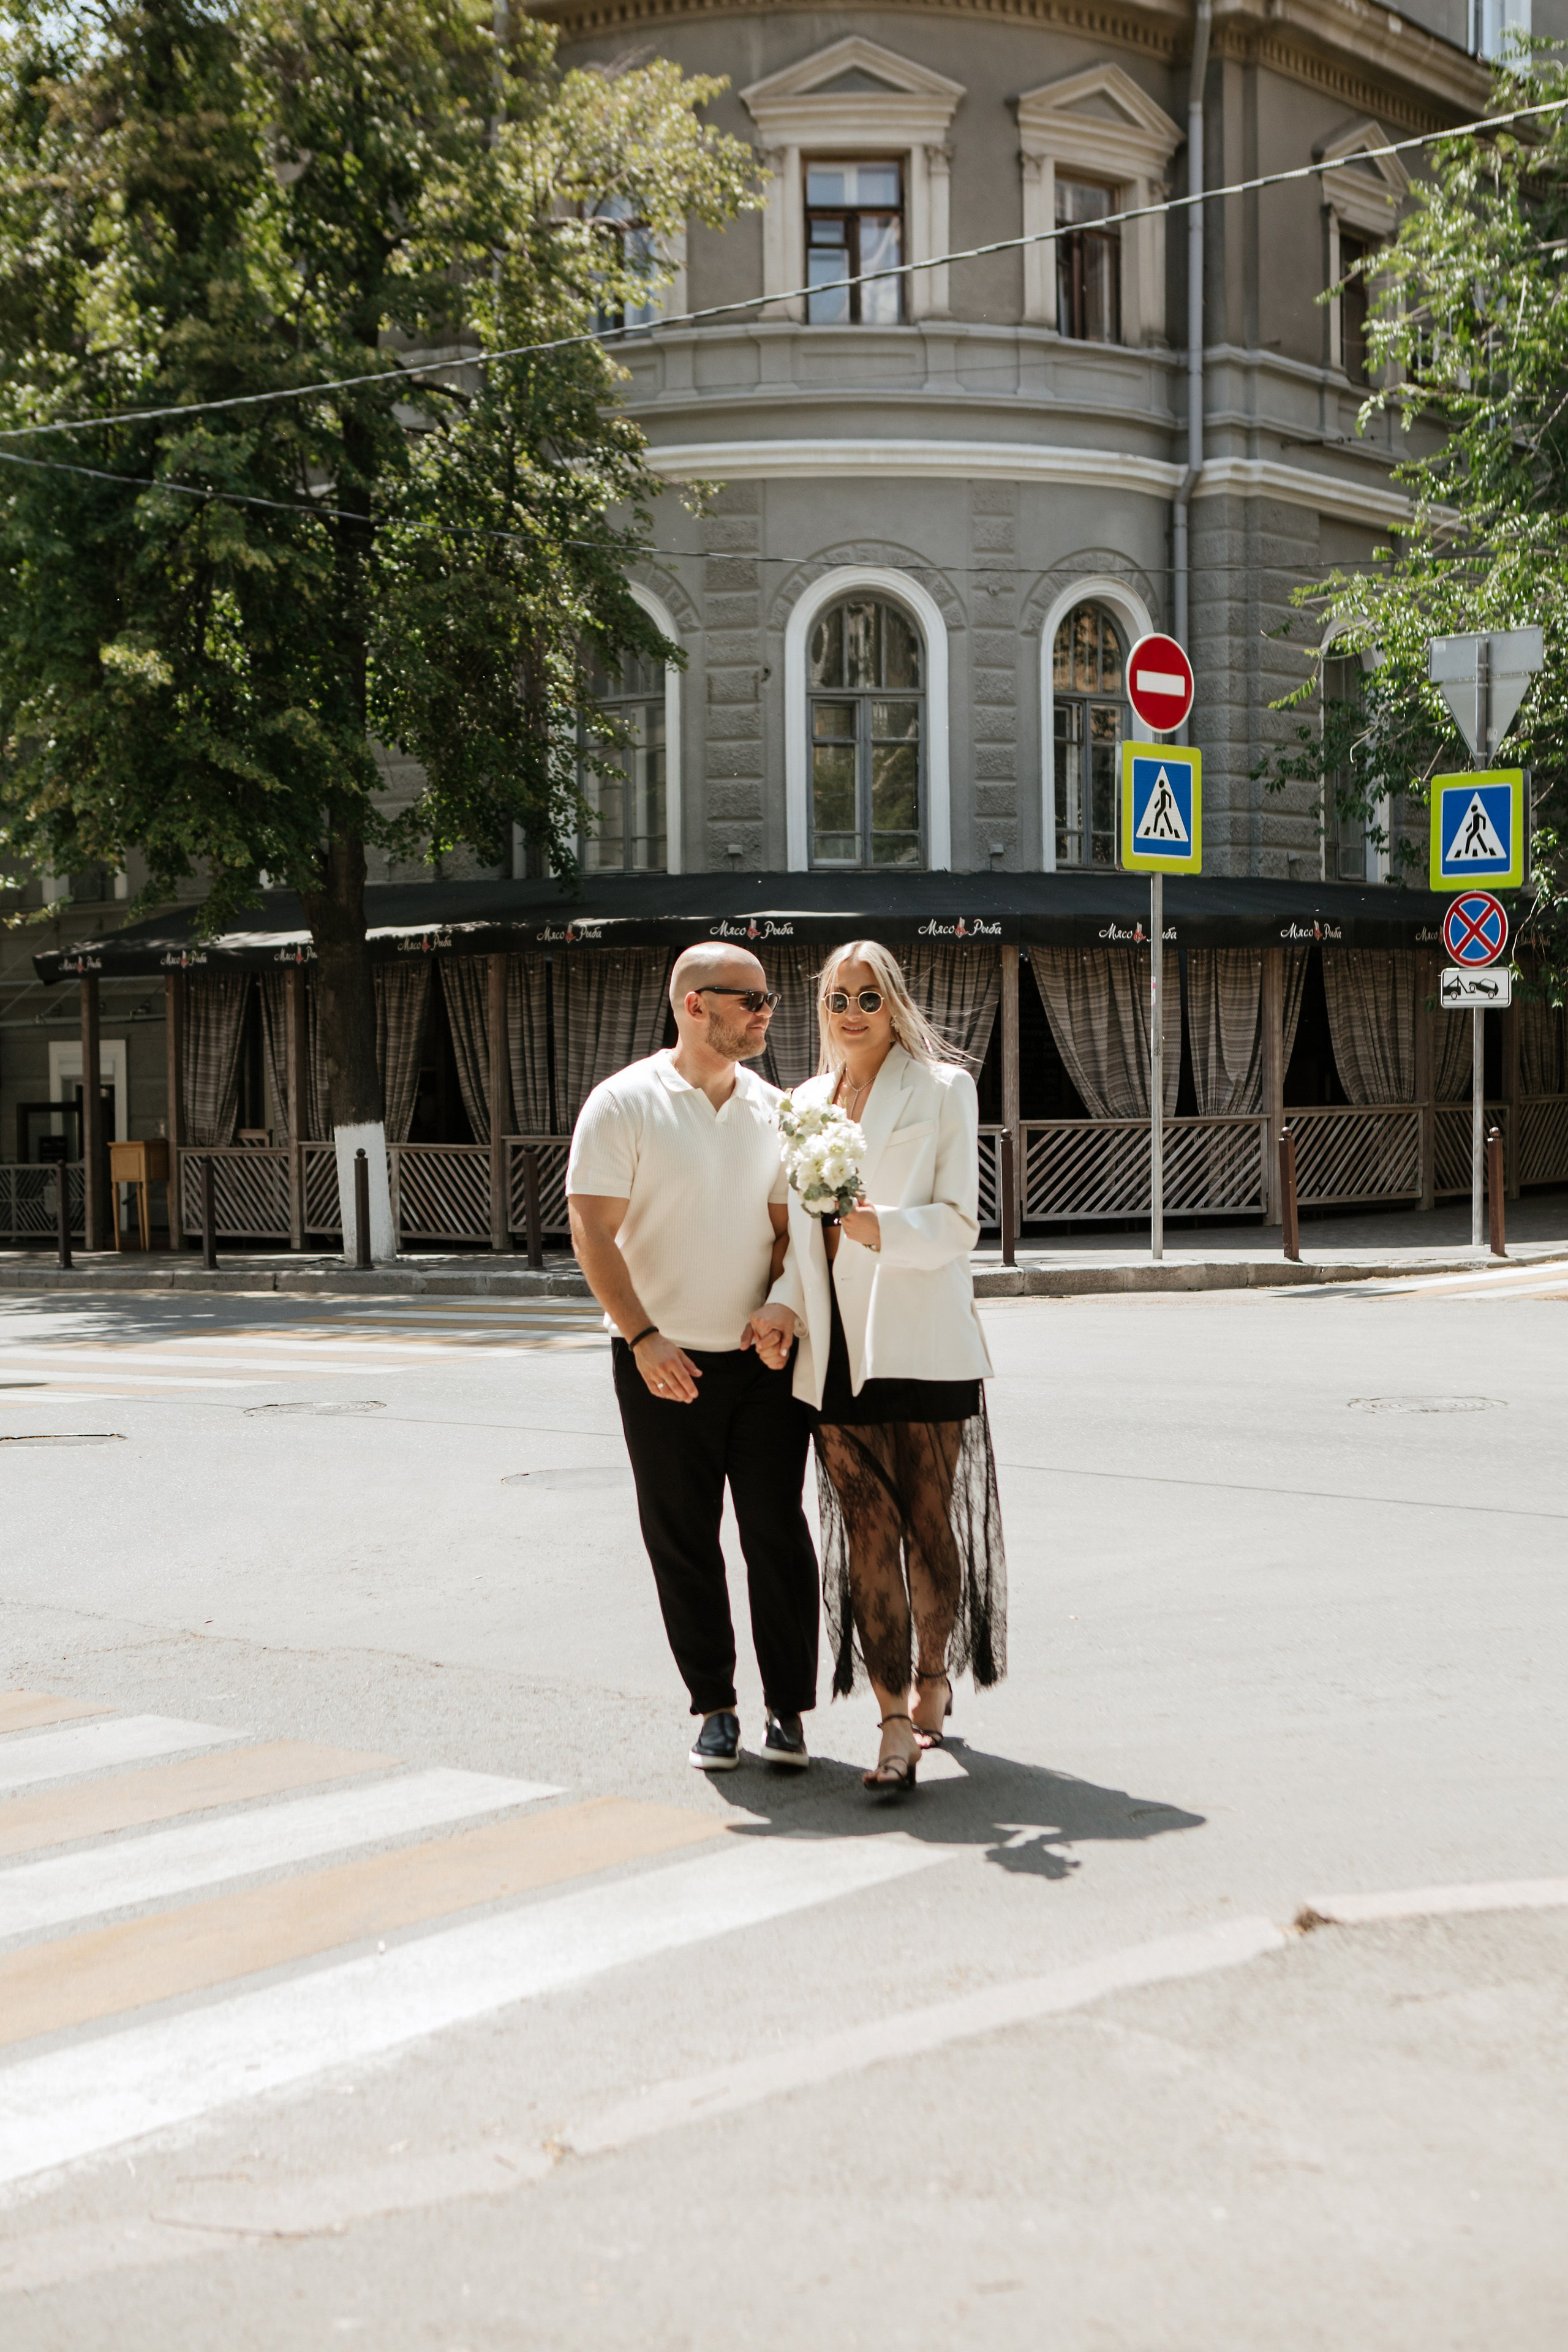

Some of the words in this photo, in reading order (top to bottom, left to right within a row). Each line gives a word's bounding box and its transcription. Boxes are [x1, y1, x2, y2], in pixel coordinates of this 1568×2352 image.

[537, 925, 565, 942] Мясо
[576, 924, 602, 941] Рыба
[710, 919, 746, 937] Мясо
[760, 921, 794, 939] Рыба
[918, 919, 955, 936] Мясо
[968, 919, 1001, 936] Рыба
[1099, 922, 1133, 940] Мясо
[1280, 922, 1313, 940] Мясо
[1322, 923, 1341, 940] Рыба
[1415, 926, 1438, 943] Мясо
[398, 937, 421, 951] Мясо
[431, 933, 452, 950] Рыба
[160, 951, 180, 965] Мясо
[274, 948, 295, 961] Мясо
